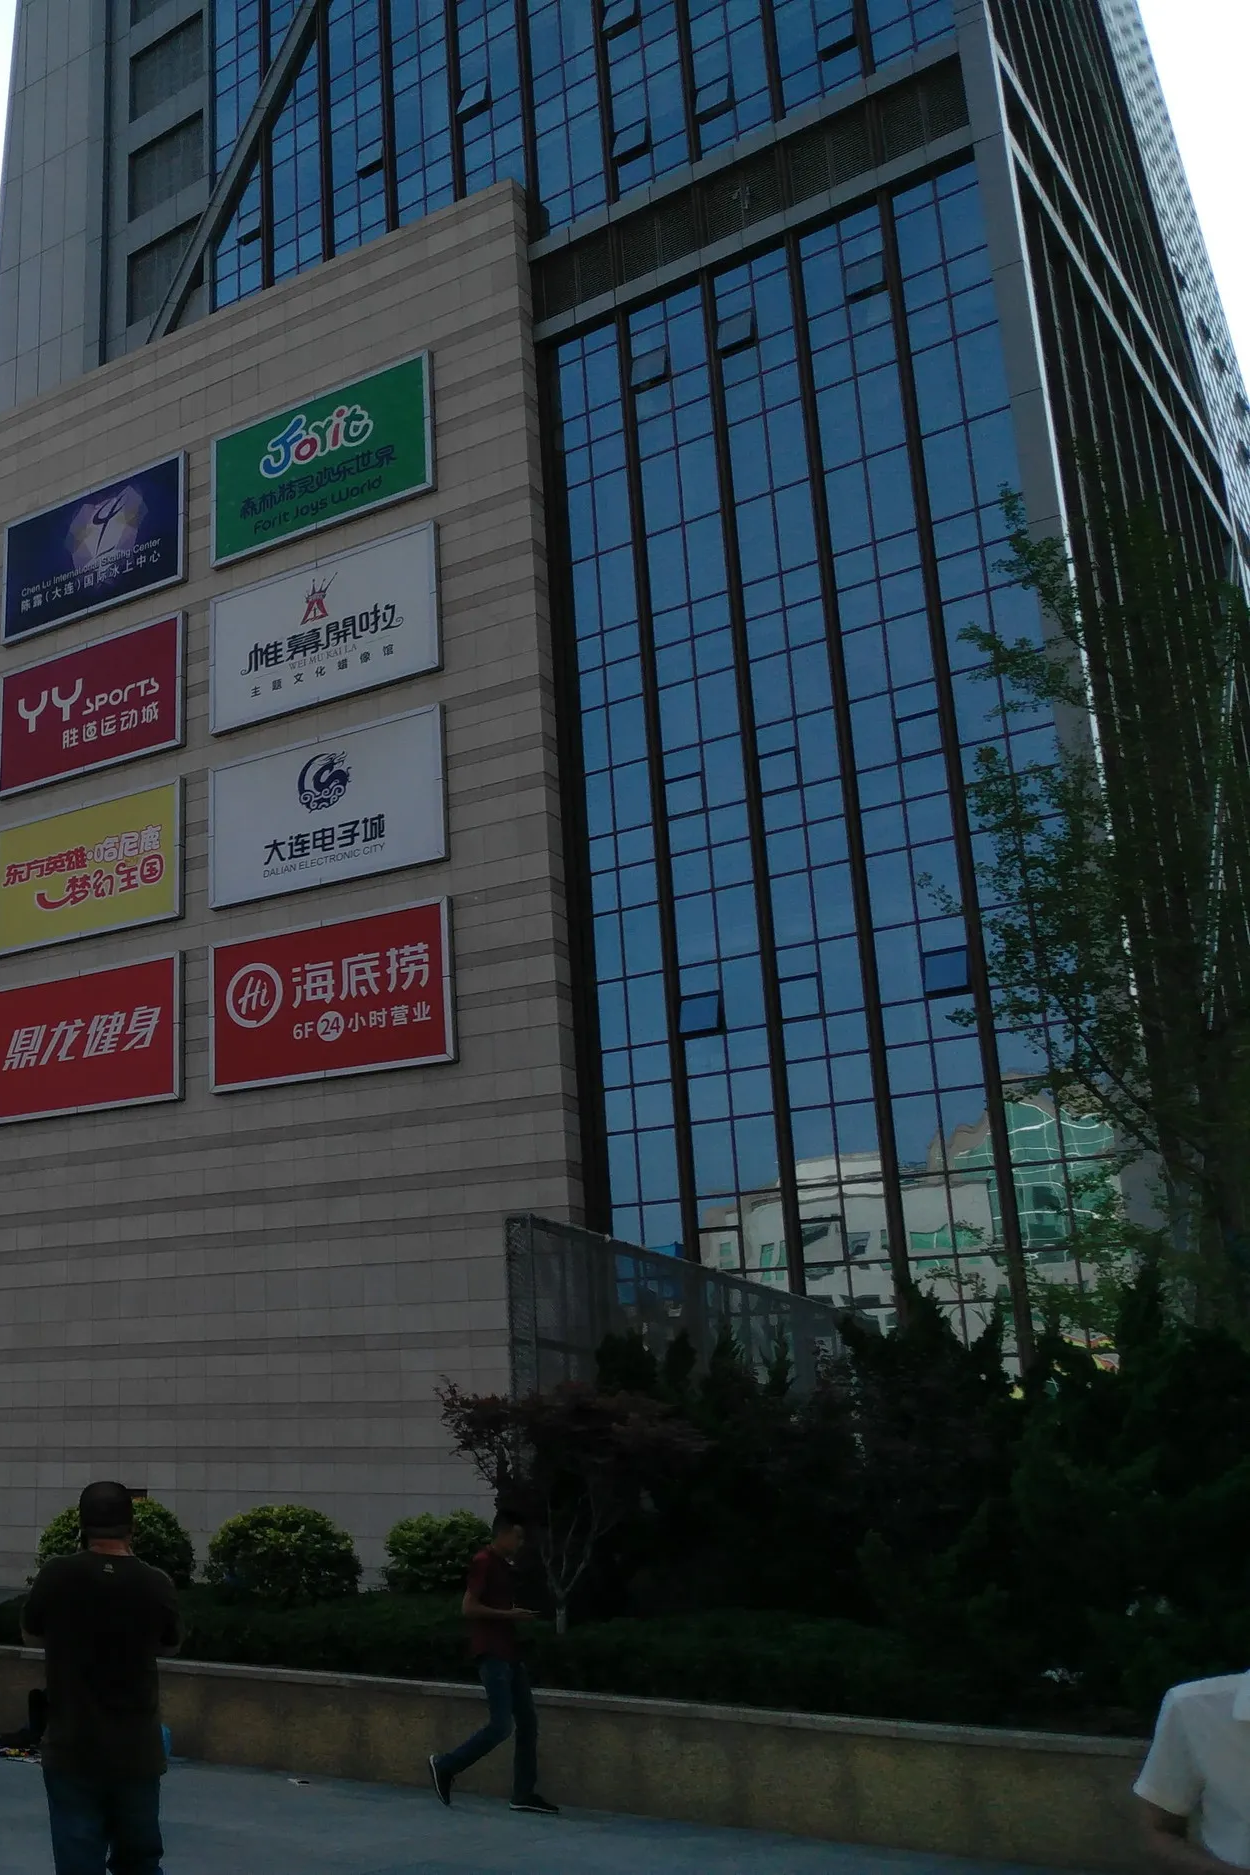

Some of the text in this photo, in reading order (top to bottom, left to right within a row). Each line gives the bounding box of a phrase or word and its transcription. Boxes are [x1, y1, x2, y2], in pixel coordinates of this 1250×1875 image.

[294, 497, 328, 517] Joys
[331, 475, 383, 504] World
[21, 538, 161, 597] Chen Lu International Skating Center
[251, 644, 394, 698] 主题文化蜡像馆
[18, 678, 83, 733] YY
[62, 701, 160, 749] 胜道运动城
[263, 843, 385, 878] DALIAN ELECTRONIC CITY
[264, 814, 385, 865] 大连电子城
[36, 854, 164, 909] 梦幻王国
[292, 942, 429, 1008] 海底捞
[2, 1006, 161, 1071] 鼎龙健身
